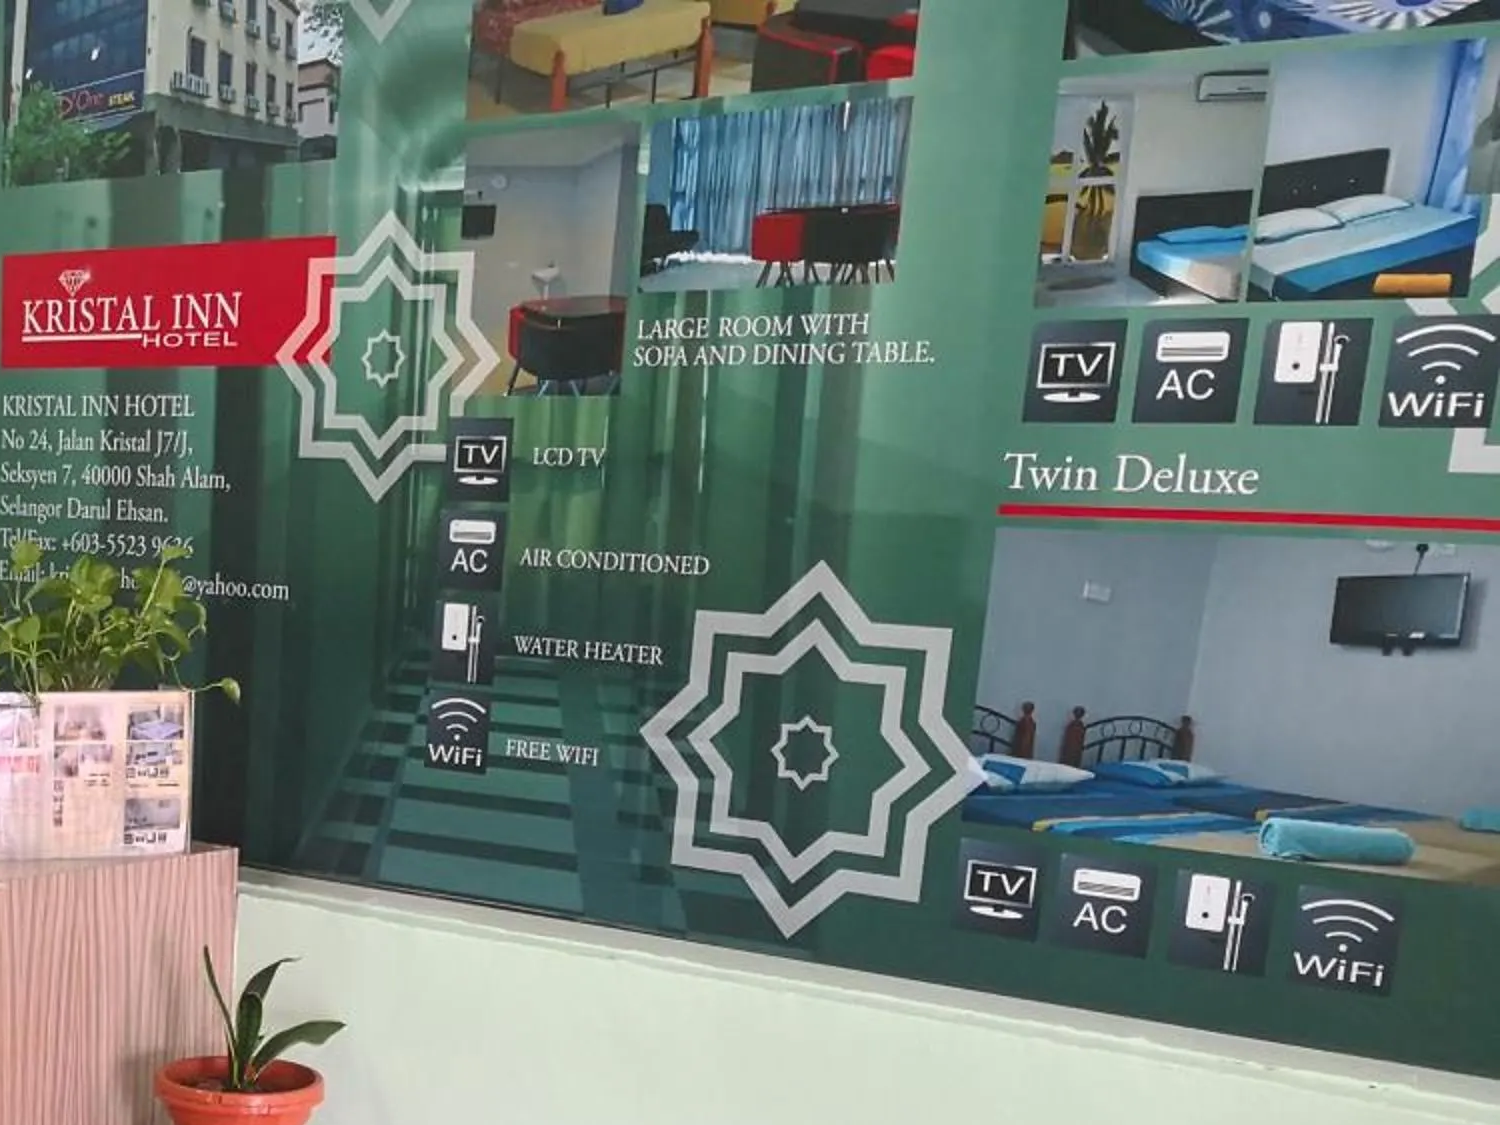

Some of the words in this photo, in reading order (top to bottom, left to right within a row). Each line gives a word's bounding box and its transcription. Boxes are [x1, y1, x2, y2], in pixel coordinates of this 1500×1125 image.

[22, 296, 161, 335] KRISTAL
[172, 290, 243, 330] INN
[637, 316, 710, 340] LARGE
[718, 314, 794, 338] ROOM
[800, 312, 870, 336] WITH
[141, 331, 239, 349] HOTEL
[633, 345, 690, 367] SOFA
[693, 344, 746, 367] AND
[752, 342, 846, 366] DINING
[852, 340, 936, 364] TABLE.
[1051, 352, 1105, 379] TV
[1156, 368, 1215, 401] AC
[3, 394, 77, 417] KRISTAL
[82, 394, 120, 418] INN
[124, 394, 196, 418] HOTEL
[1387, 391, 1485, 419] WiFi
[1, 429, 25, 450] No
[56, 429, 94, 456] Jalan
[100, 430, 151, 453] Kristal
[462, 445, 500, 466] TV
[533, 447, 574, 467] LCD
[577, 448, 607, 468] TV
[0, 461, 57, 490] Seksyen
[63, 464, 77, 487] 7,
[81, 465, 131, 487] 40000
[136, 465, 176, 489] Shah
[180, 466, 232, 493] Alam,
[1002, 452, 1099, 492] Twin
[1113, 453, 1260, 497] Deluxe
[0, 495, 63, 524] Selangor
[67, 497, 112, 521] Darul
[116, 499, 170, 523] Ehsan.
[62, 531, 148, 558] +603-5523
[451, 548, 488, 574] AC
[519, 548, 552, 569] AIR
[557, 550, 711, 576] CONDITIONED
[514, 635, 579, 659] WATER
[584, 641, 664, 667] HEATER
[427, 743, 483, 768] WiFi
[505, 739, 551, 760] FREE
[556, 743, 599, 767] WIFI
[975, 869, 1027, 897] TV
[1073, 902, 1128, 934] AC
[1293, 950, 1386, 988] WiFi
